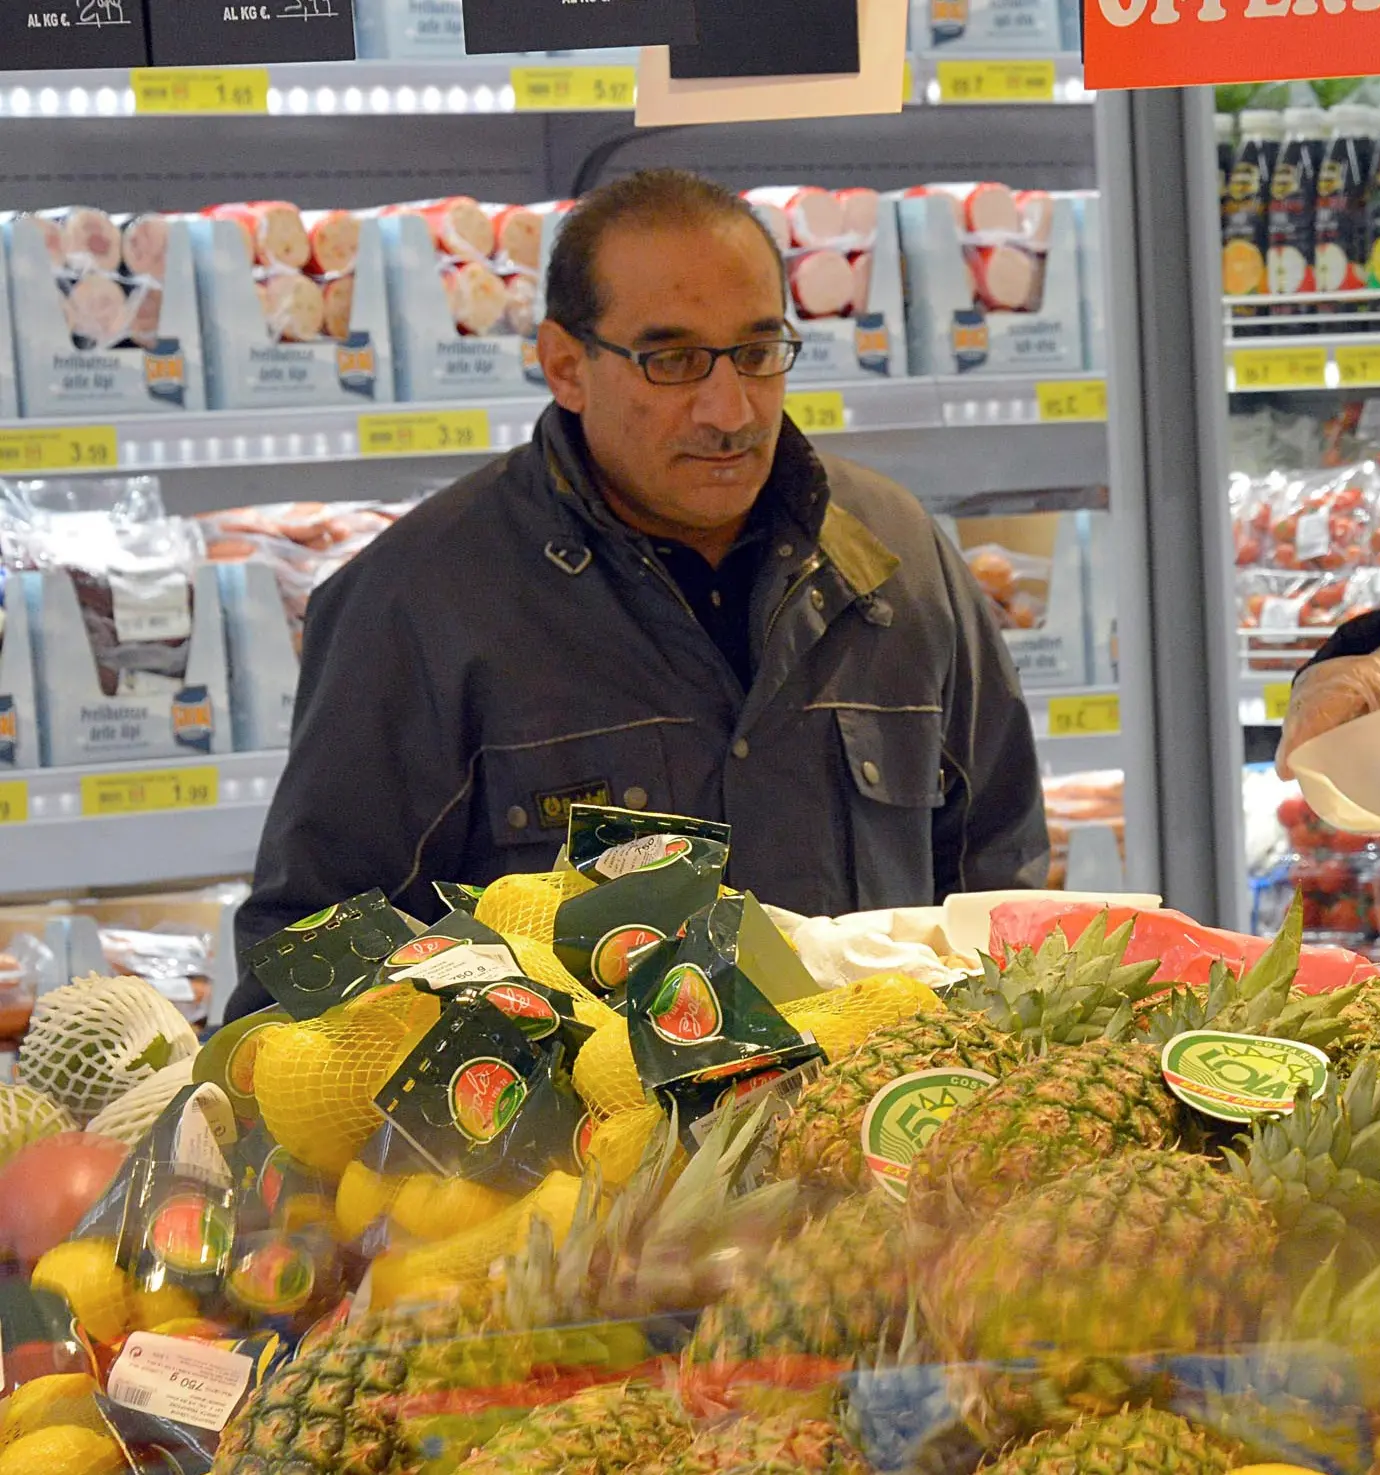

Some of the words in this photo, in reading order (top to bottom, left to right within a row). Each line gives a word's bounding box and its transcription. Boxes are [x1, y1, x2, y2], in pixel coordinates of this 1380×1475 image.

[27, 13, 42, 28] AL
[43, 13, 59, 27] KG
[223, 6, 239, 21] AL
[240, 6, 257, 20] KG
[169, 1371, 178, 1382] g
[179, 1376, 206, 1392] 750
